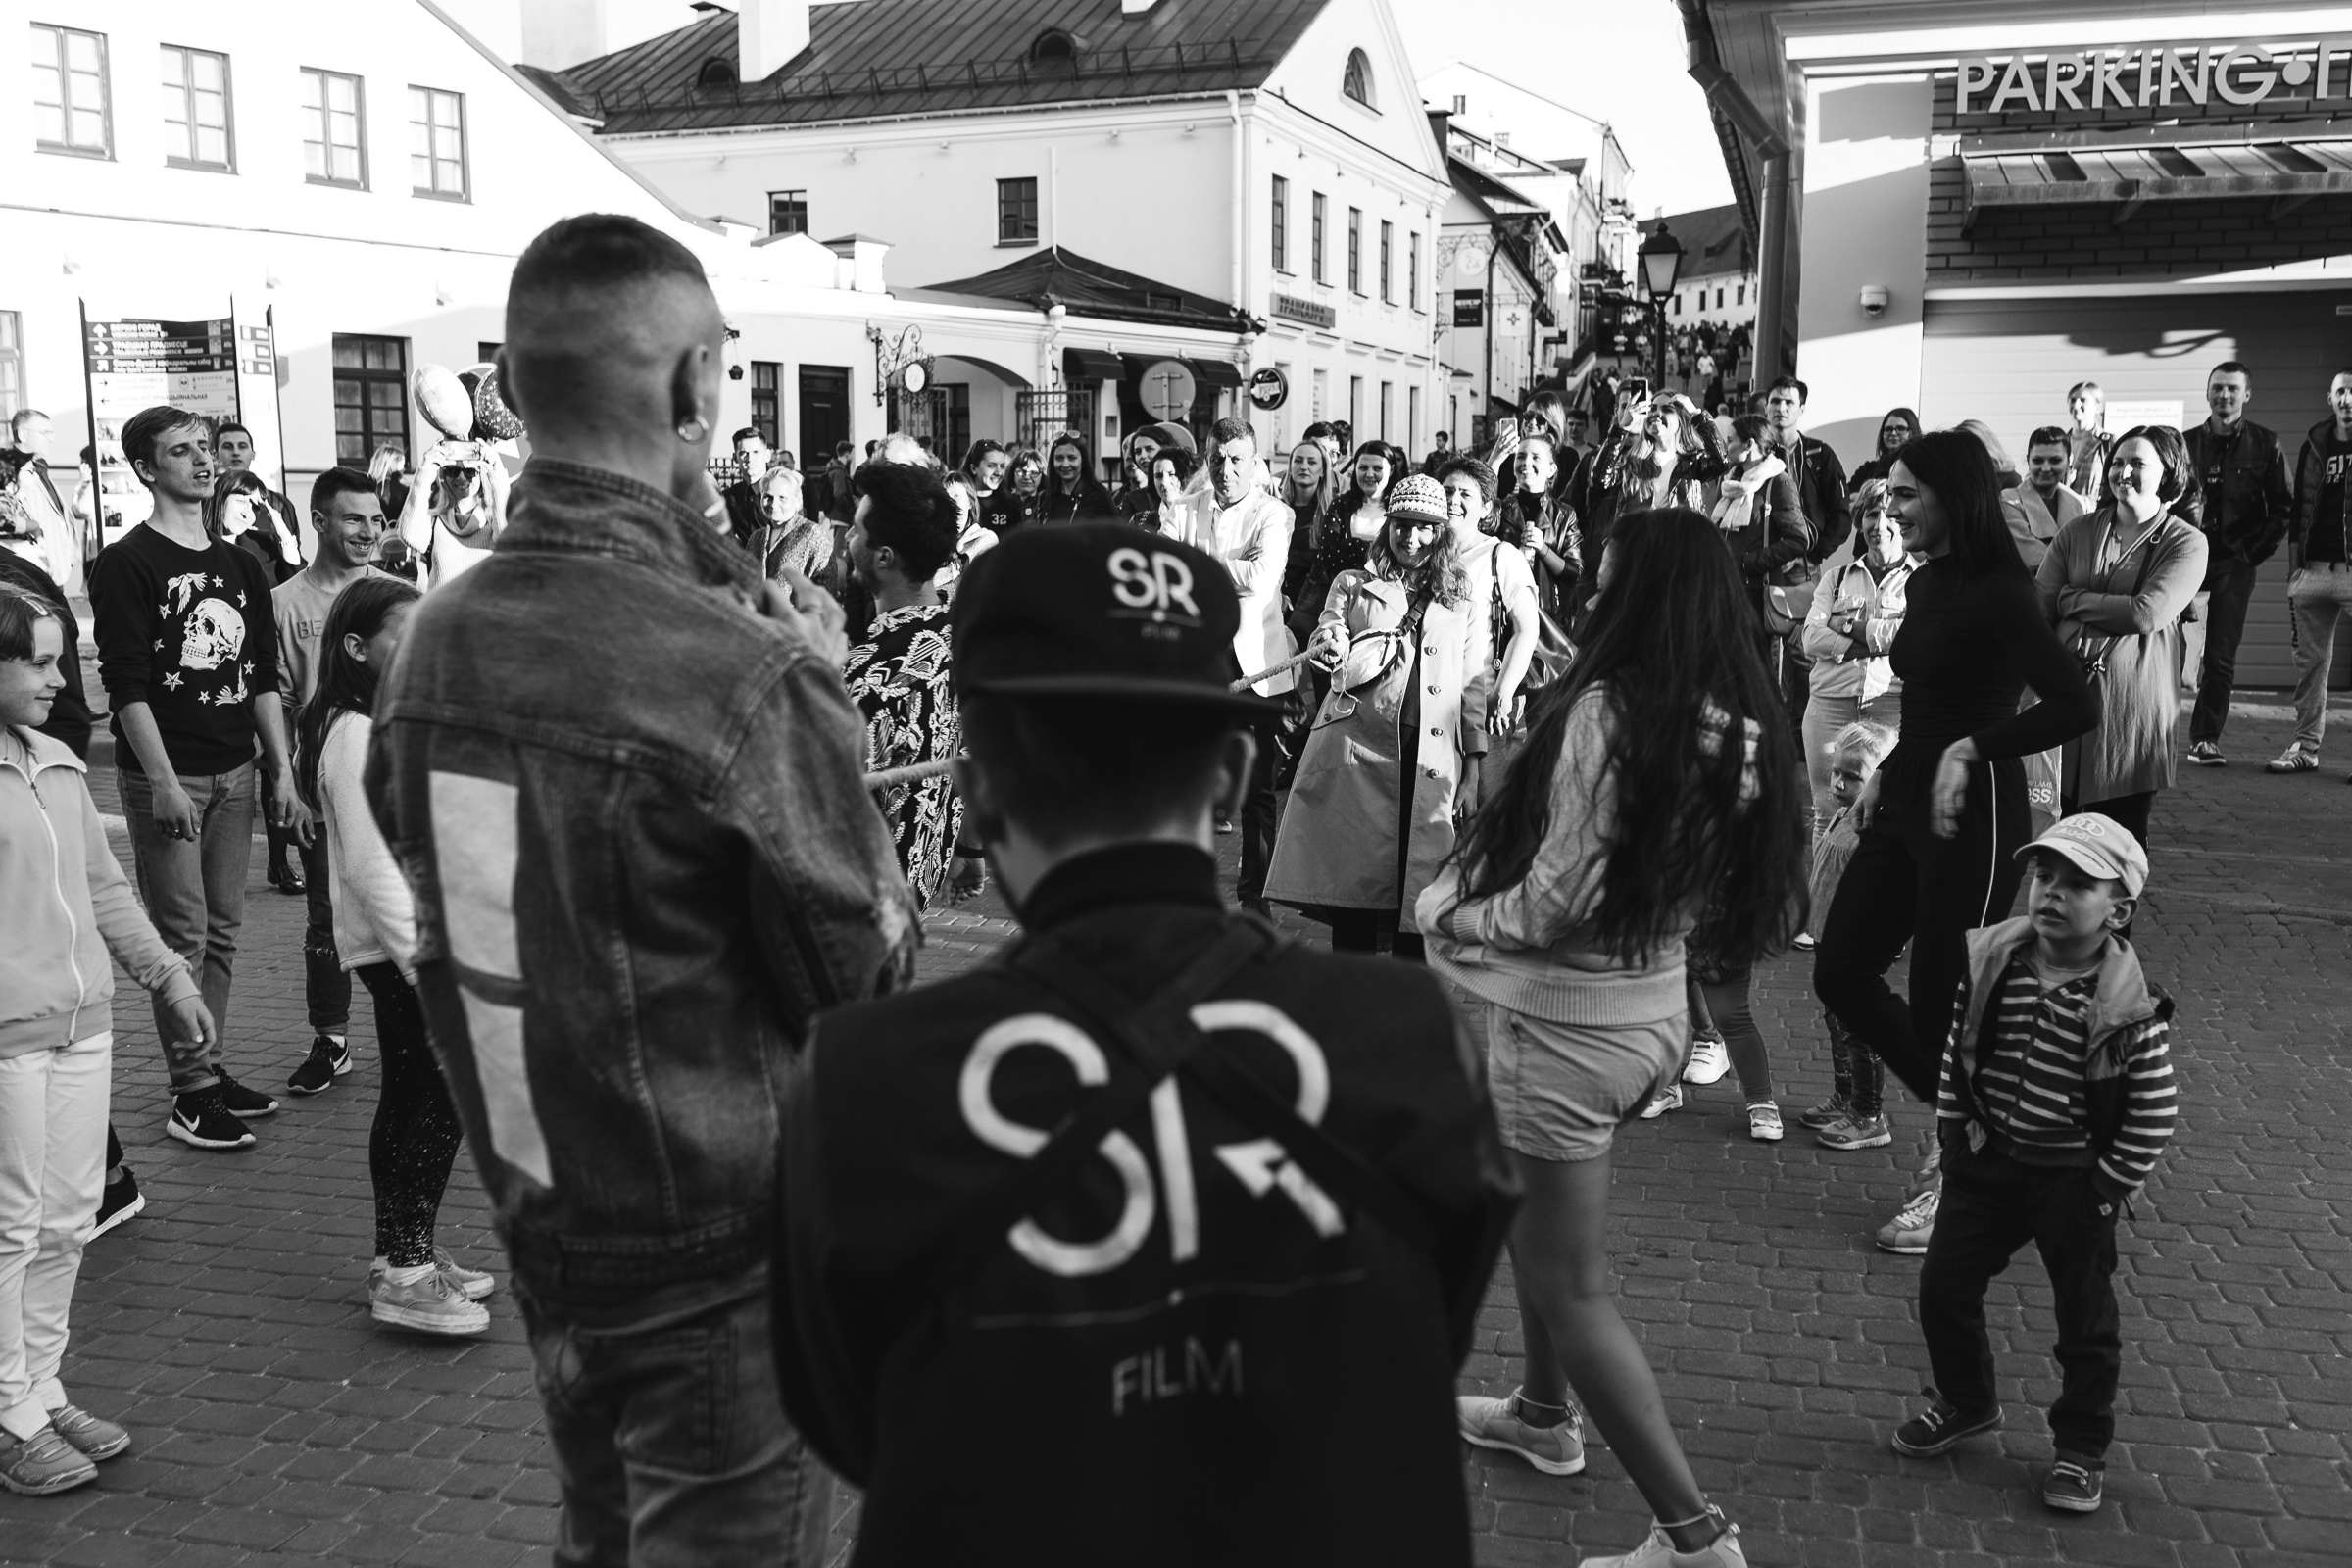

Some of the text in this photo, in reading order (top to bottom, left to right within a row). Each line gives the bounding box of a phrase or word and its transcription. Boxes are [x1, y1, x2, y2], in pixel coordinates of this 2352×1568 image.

[1957, 45, 2278, 114] PARKING
[991, 513, 1007, 525] 32
[1107, 548, 1201, 617] SR
[958, 999, 1348, 1278] SR
[1111, 1334, 1244, 1418] FILM
